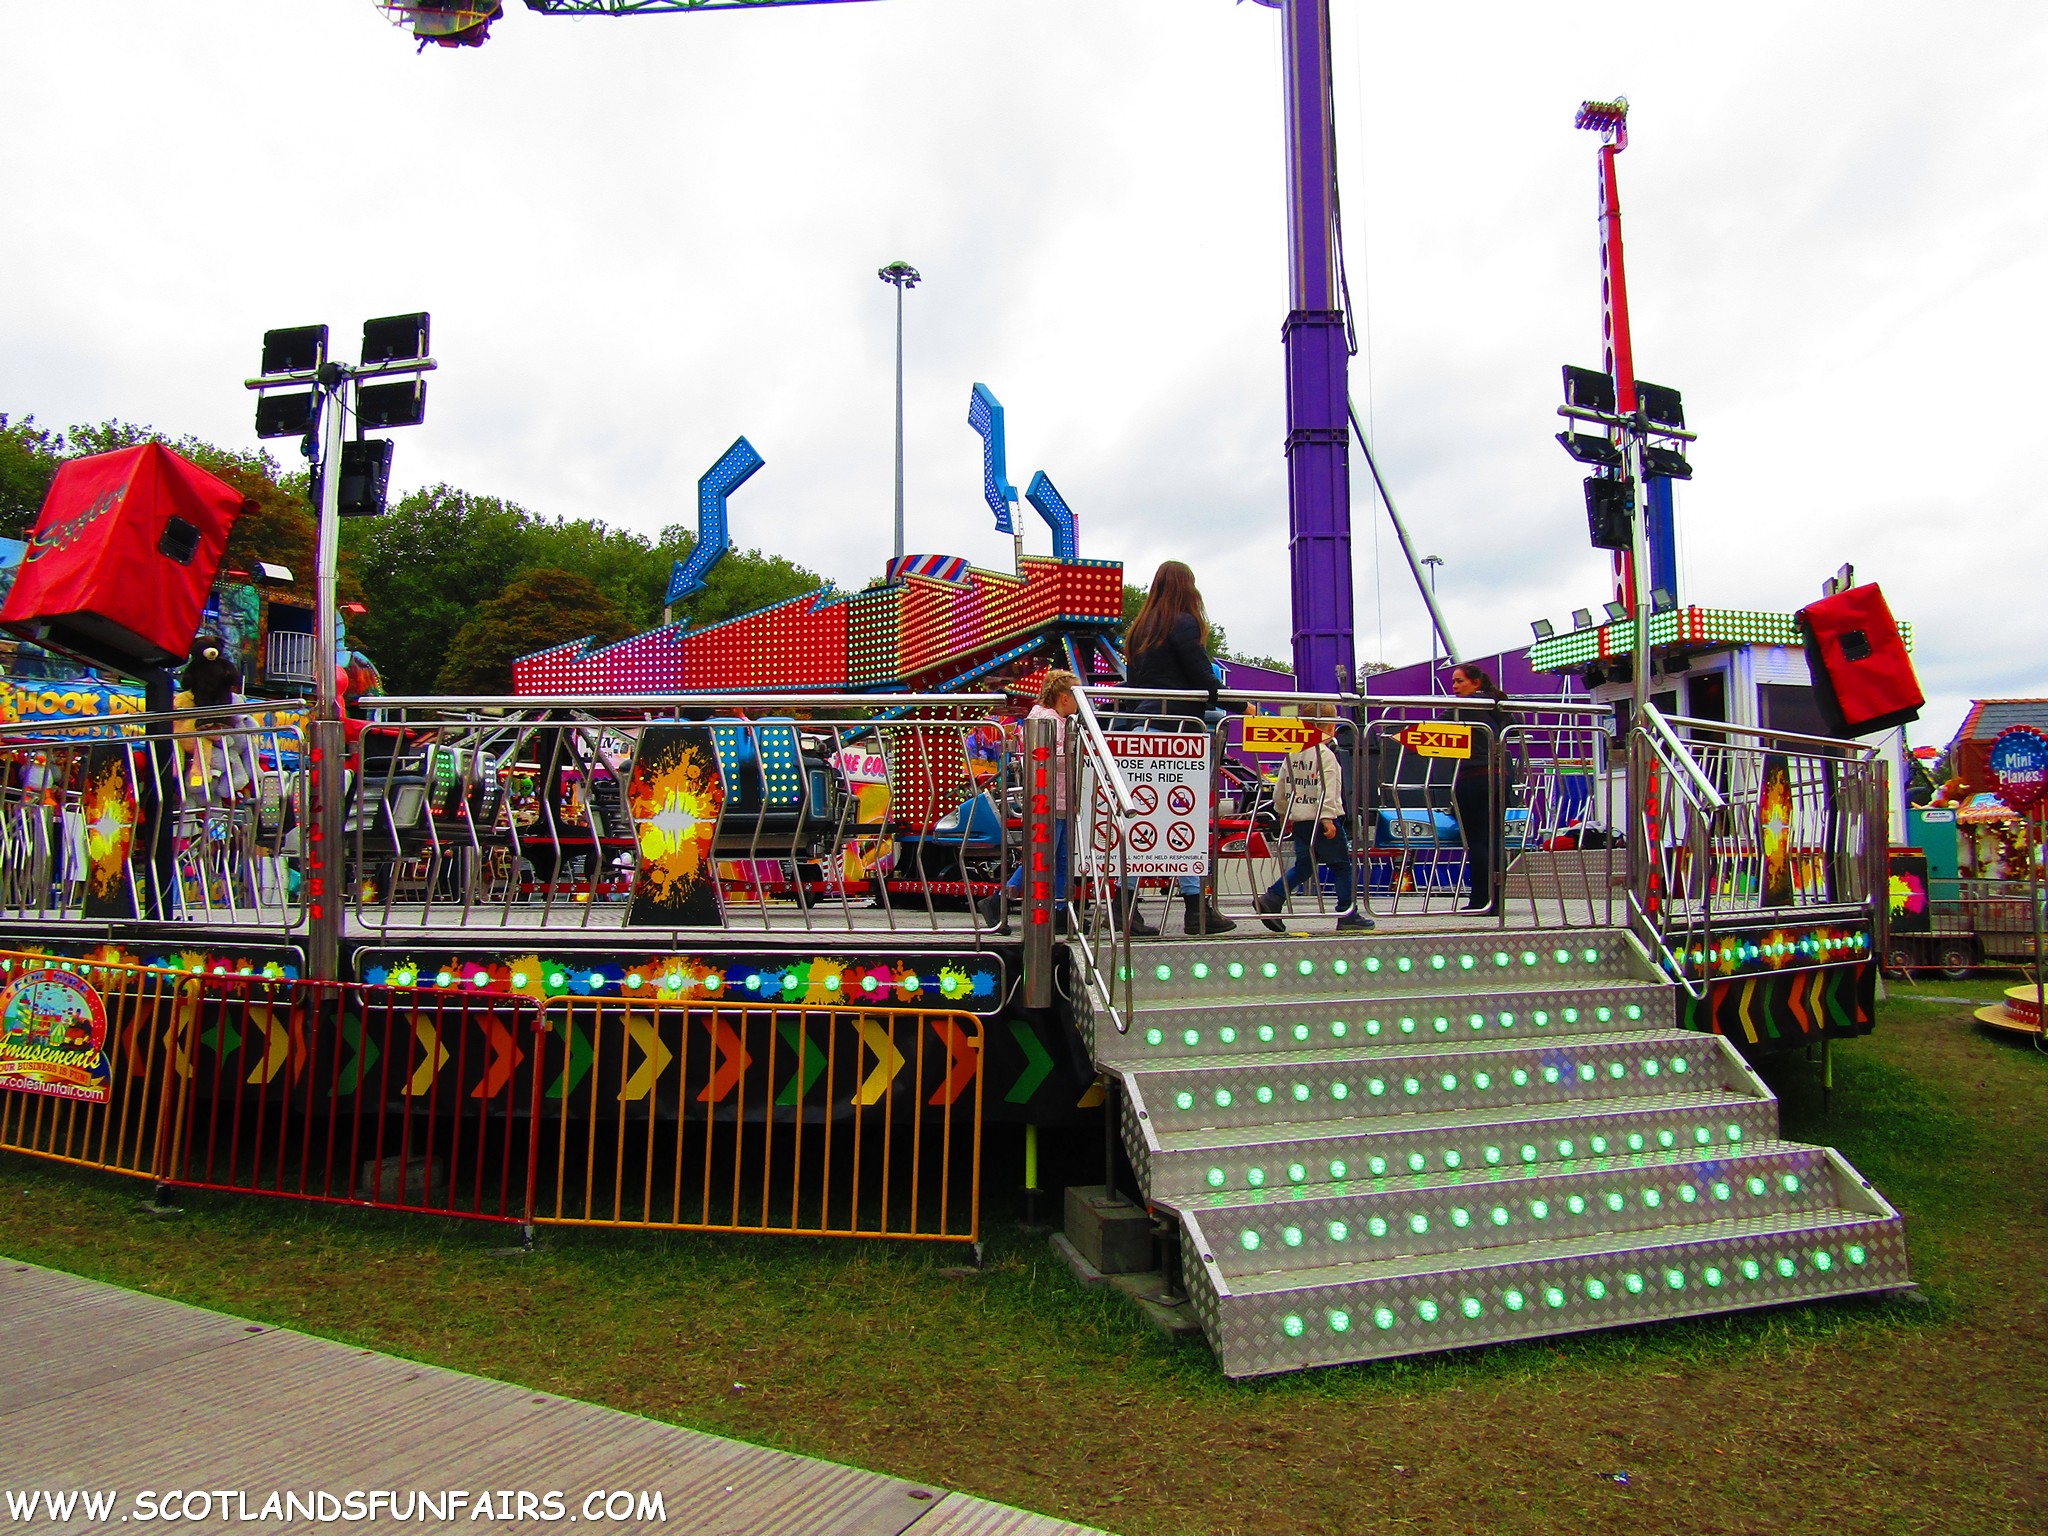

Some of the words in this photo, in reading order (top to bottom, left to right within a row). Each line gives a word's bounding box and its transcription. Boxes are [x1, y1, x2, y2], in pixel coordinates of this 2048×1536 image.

[16, 691, 101, 715] HOOK
[1253, 727, 1314, 743] EXIT
[1406, 731, 1462, 748] EXIT
[1090, 736, 1202, 756] TENTION
[1150, 760, 1205, 771] ARTICLES
[2005, 752, 2031, 768] Mini
[1127, 772, 1153, 783] THIS
[1158, 773, 1184, 783] RIDE
[1999, 769, 2040, 785] Planes
[1126, 863, 1188, 873] SMOKING
[14, 971, 46, 991] FOR
[53, 972, 90, 998] HIRE
[18, 1062, 57, 1073] BUSINESS
[59, 1066, 68, 1077] IS
